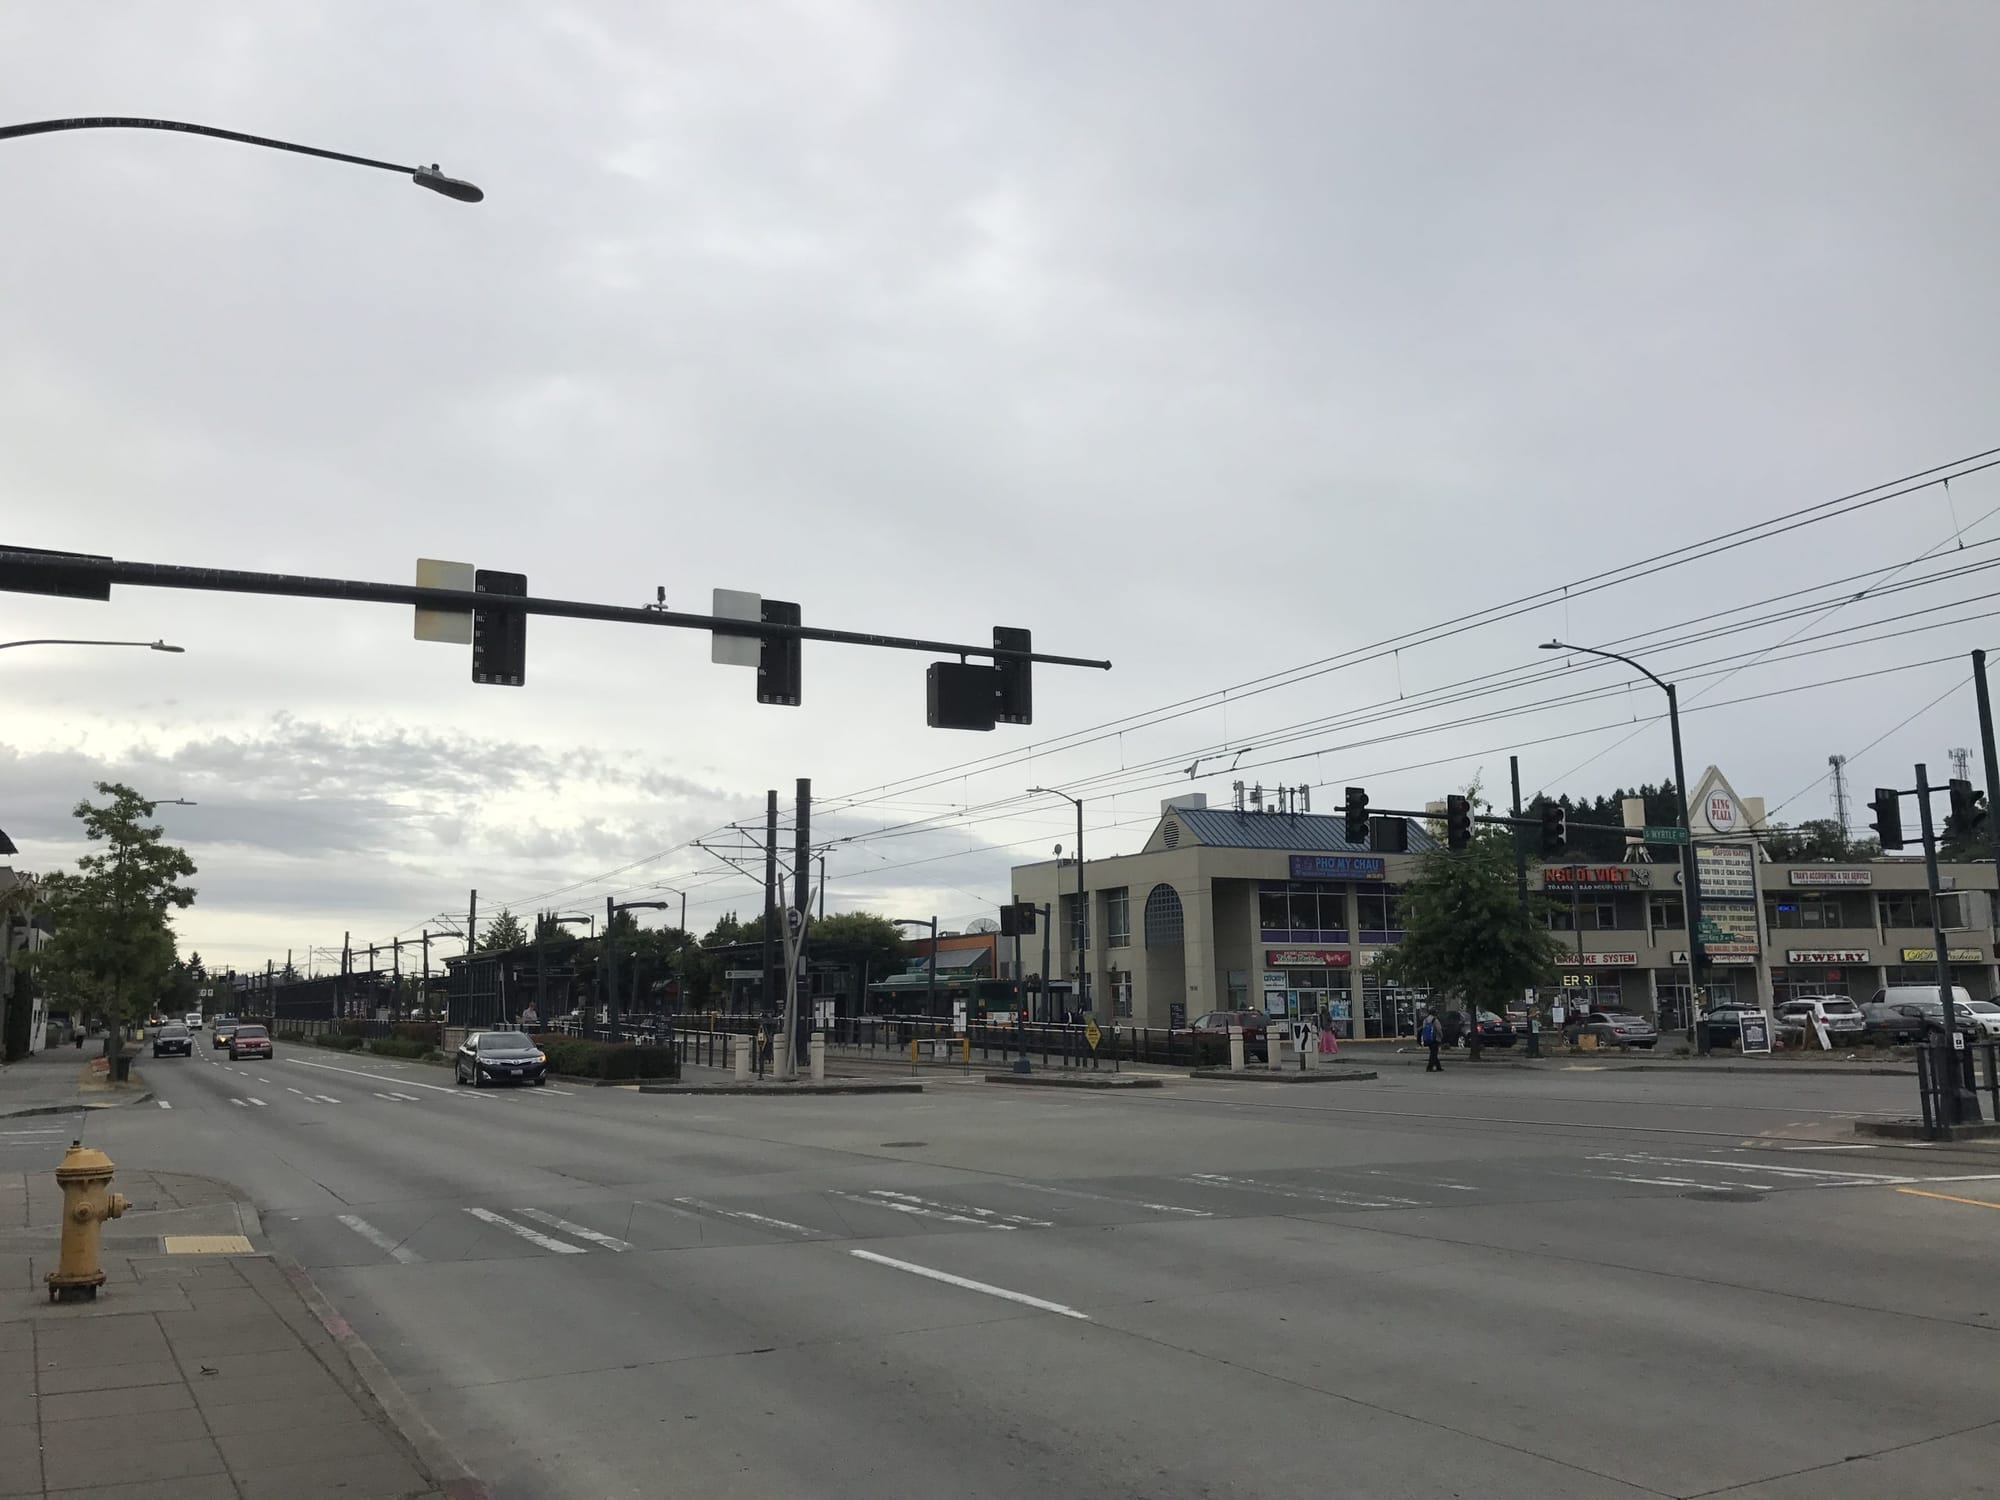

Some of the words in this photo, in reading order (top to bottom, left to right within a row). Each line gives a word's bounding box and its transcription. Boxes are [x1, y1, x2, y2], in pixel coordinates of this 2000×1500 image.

[1711, 799, 1730, 809] KING
[1711, 809, 1732, 821] PLAZA
[1651, 830, 1677, 840] MYRTLE
[1602, 954, 1635, 963] SYSTEM
[1793, 953, 1865, 962] JEWELRY
